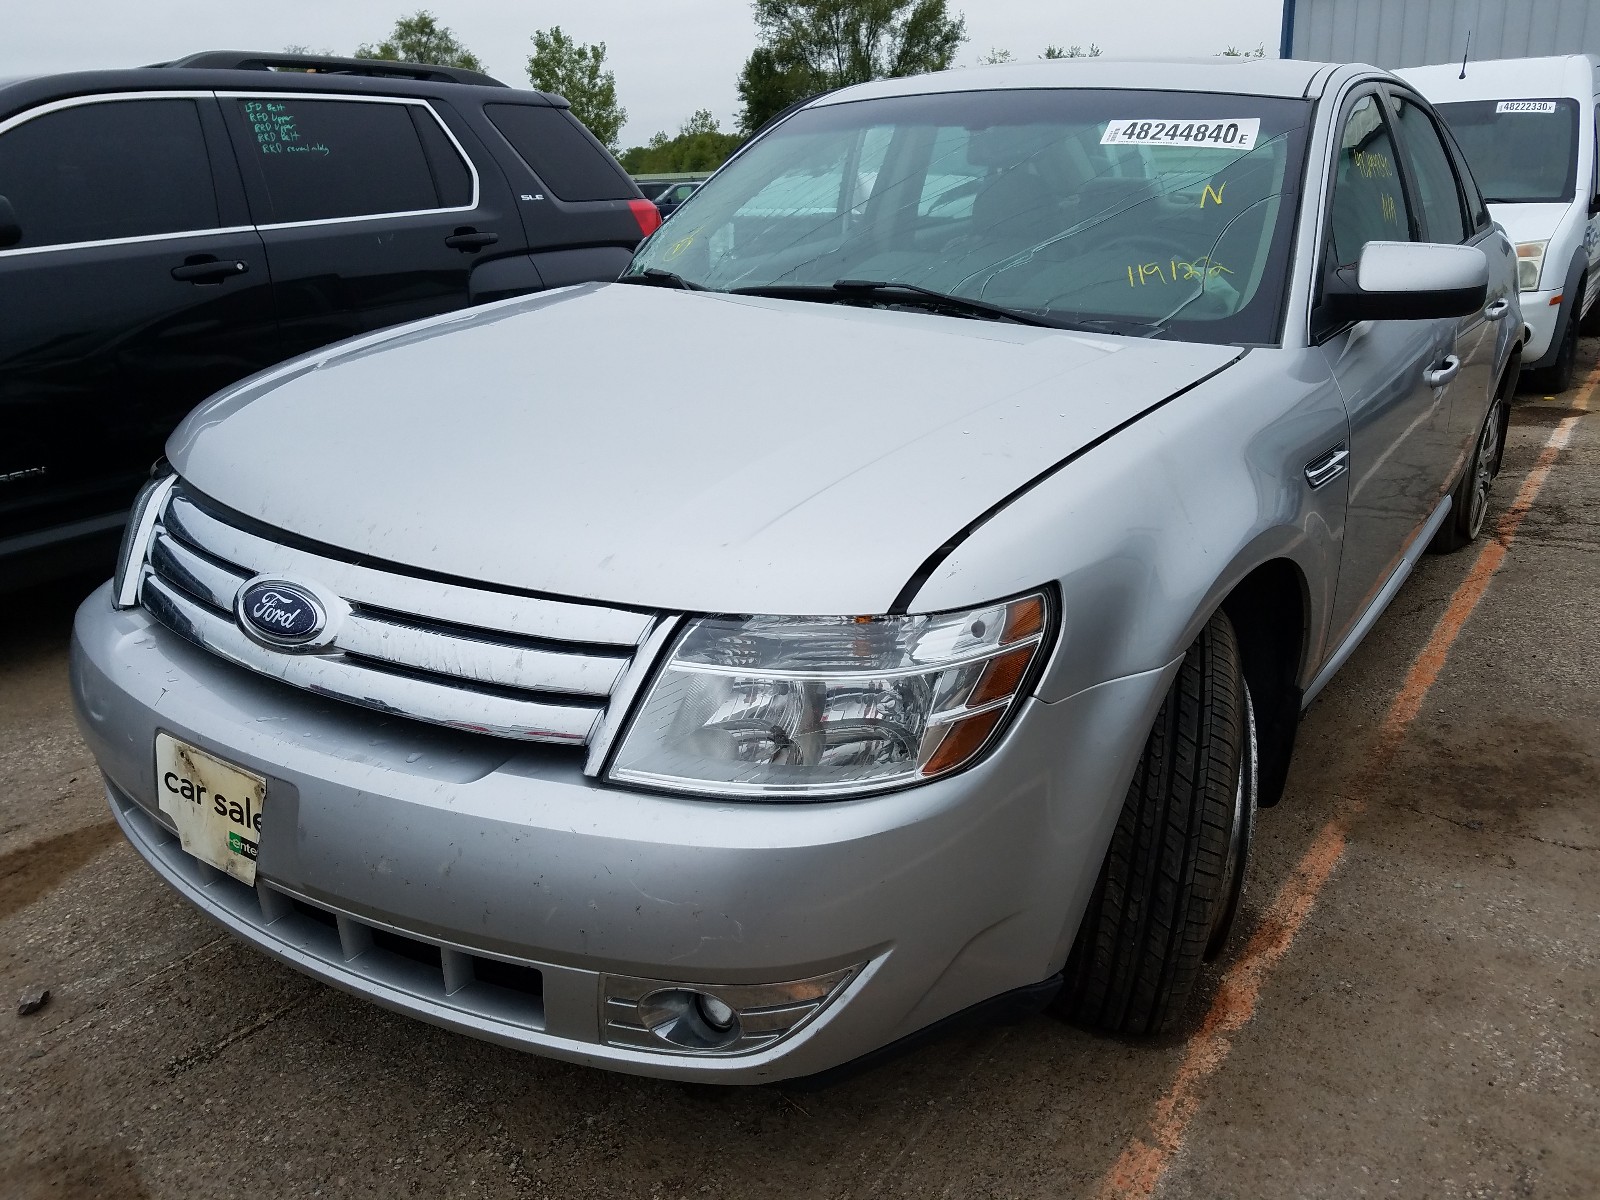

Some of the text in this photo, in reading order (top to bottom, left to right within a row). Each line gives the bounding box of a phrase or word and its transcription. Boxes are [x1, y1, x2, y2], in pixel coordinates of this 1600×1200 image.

[1503, 102, 1548, 111] 48222330
[1122, 122, 1238, 144] 48244840
[1238, 134, 1249, 145] E
[1200, 181, 1227, 208] N
[253, 592, 301, 628] Ford
[164, 771, 207, 806] car
